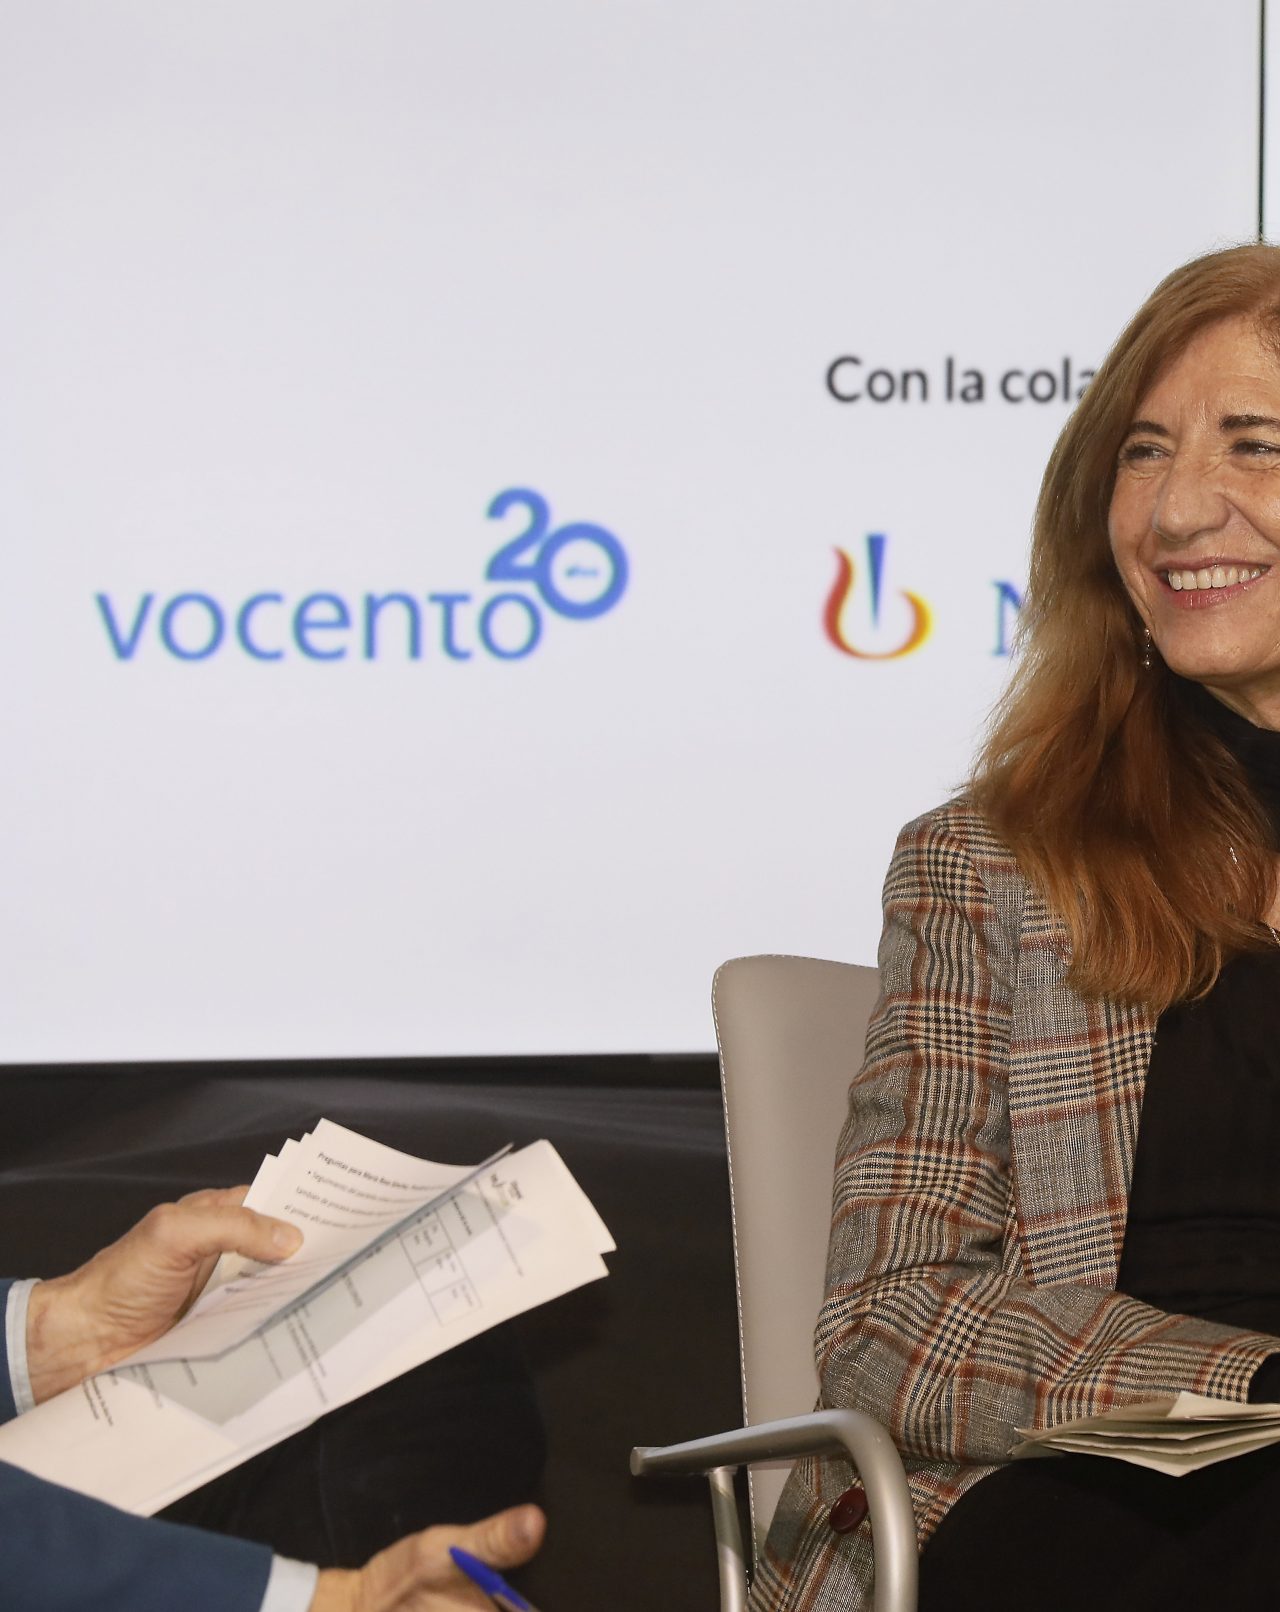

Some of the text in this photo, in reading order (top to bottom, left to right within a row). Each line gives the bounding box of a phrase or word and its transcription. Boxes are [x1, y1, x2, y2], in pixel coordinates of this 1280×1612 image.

[825, 355, 930, 404] Con
[945, 356, 986, 404] la
[484, 486, 630, 621] 20
[94, 593, 543, 662] vocento
